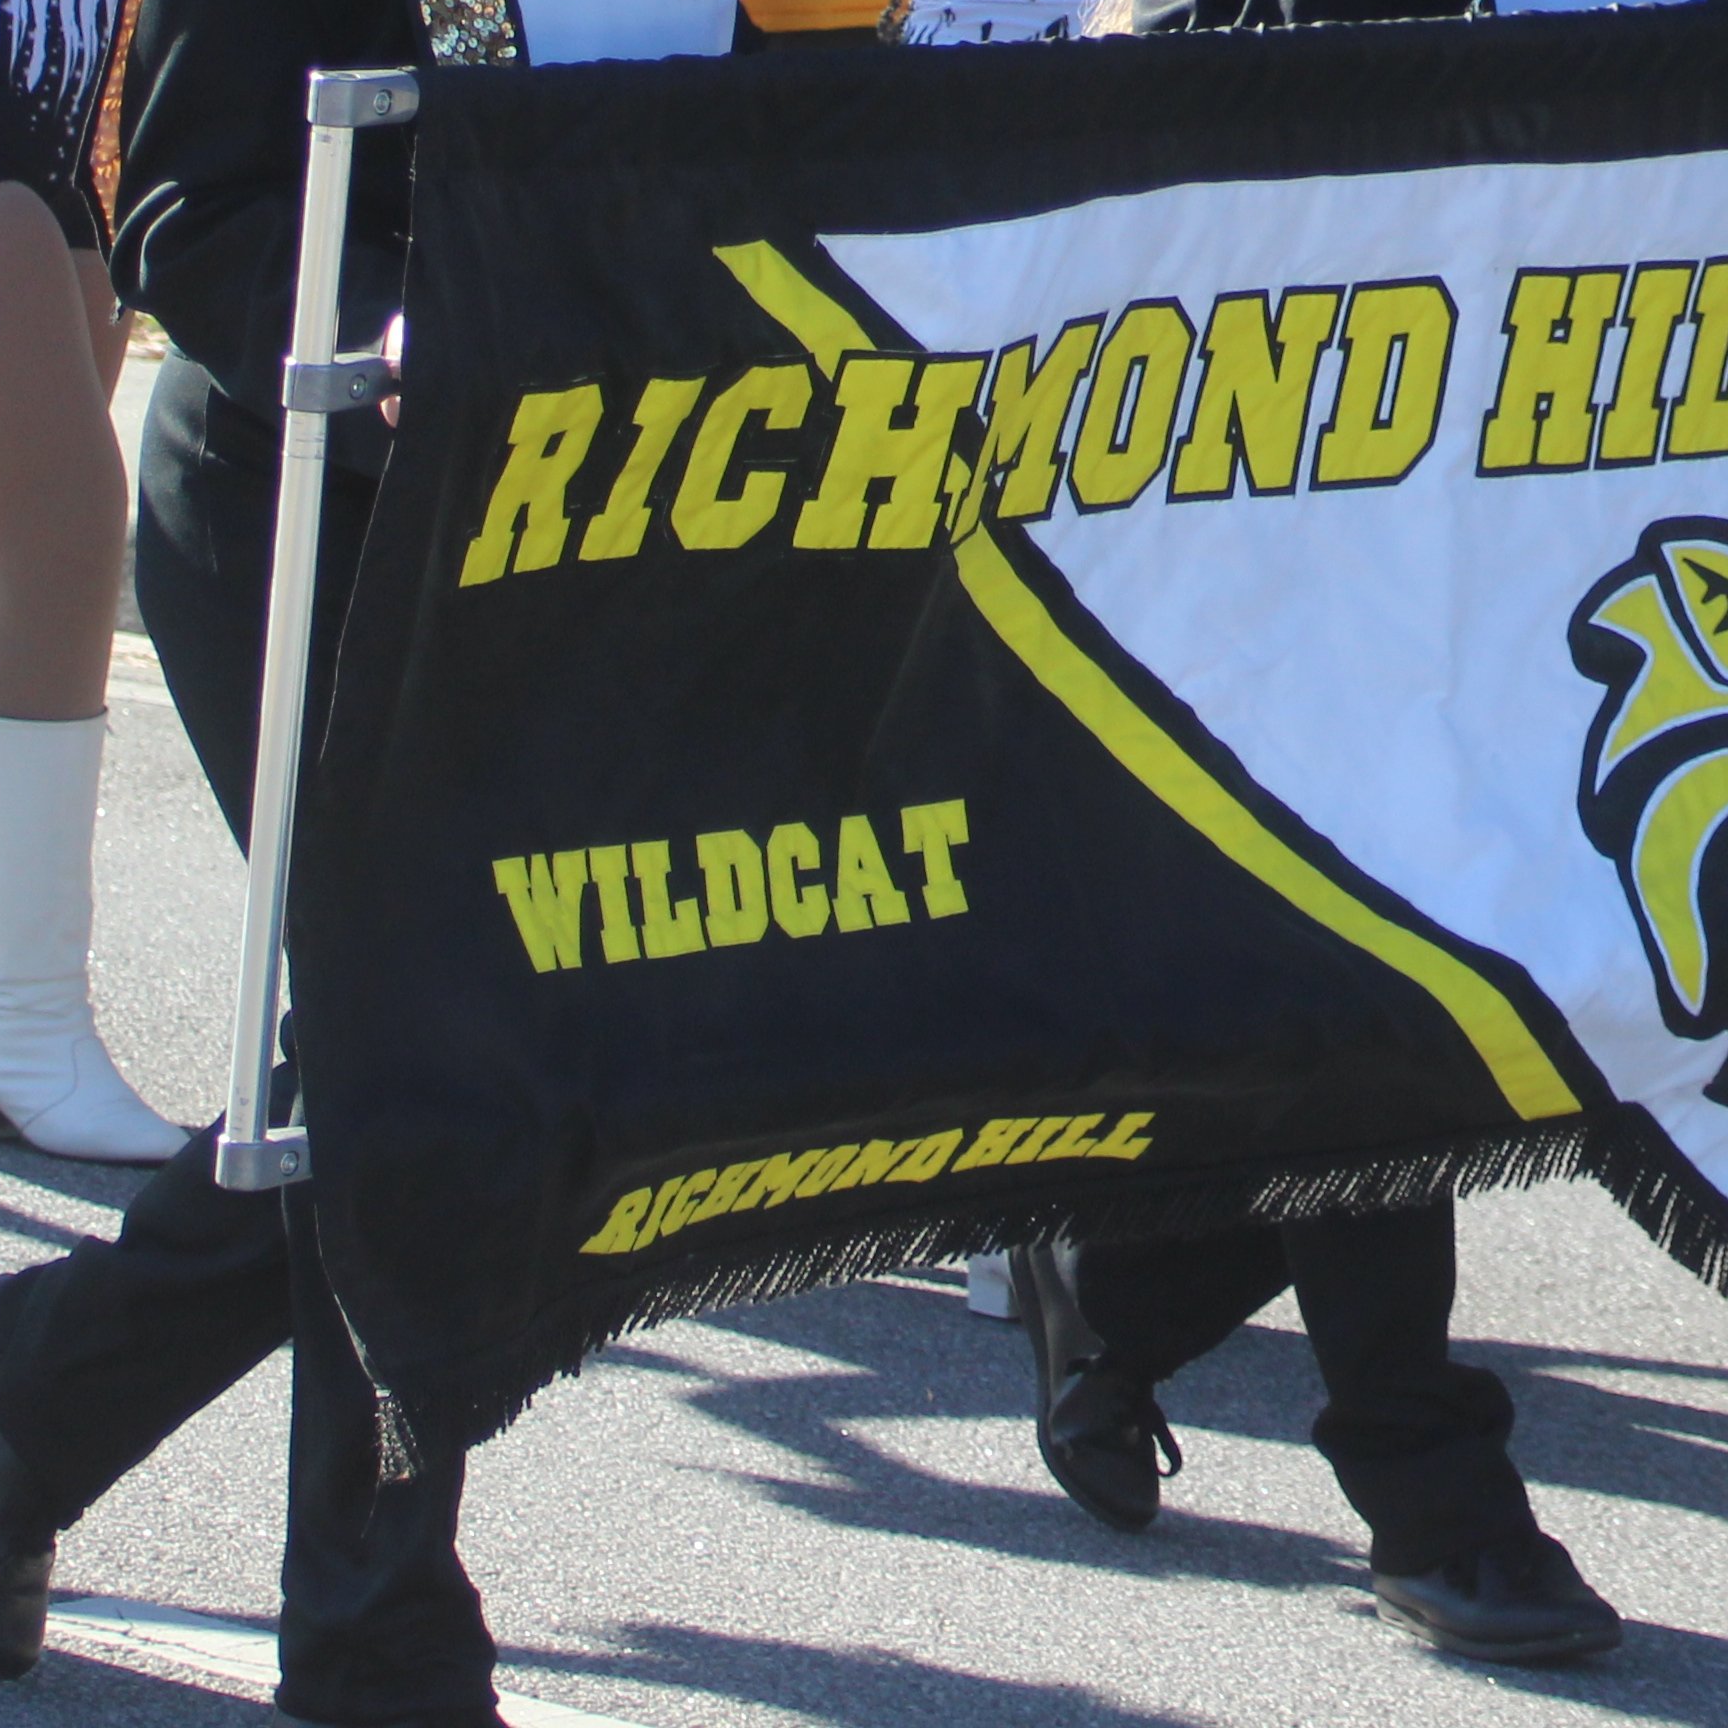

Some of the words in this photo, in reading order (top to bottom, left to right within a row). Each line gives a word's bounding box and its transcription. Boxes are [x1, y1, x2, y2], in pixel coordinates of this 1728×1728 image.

[458, 273, 1459, 588] RICHMOND
[492, 798, 970, 974] WILDCAT
[579, 1127, 964, 1256] RICHMOND
[950, 1111, 1156, 1173] HILL
